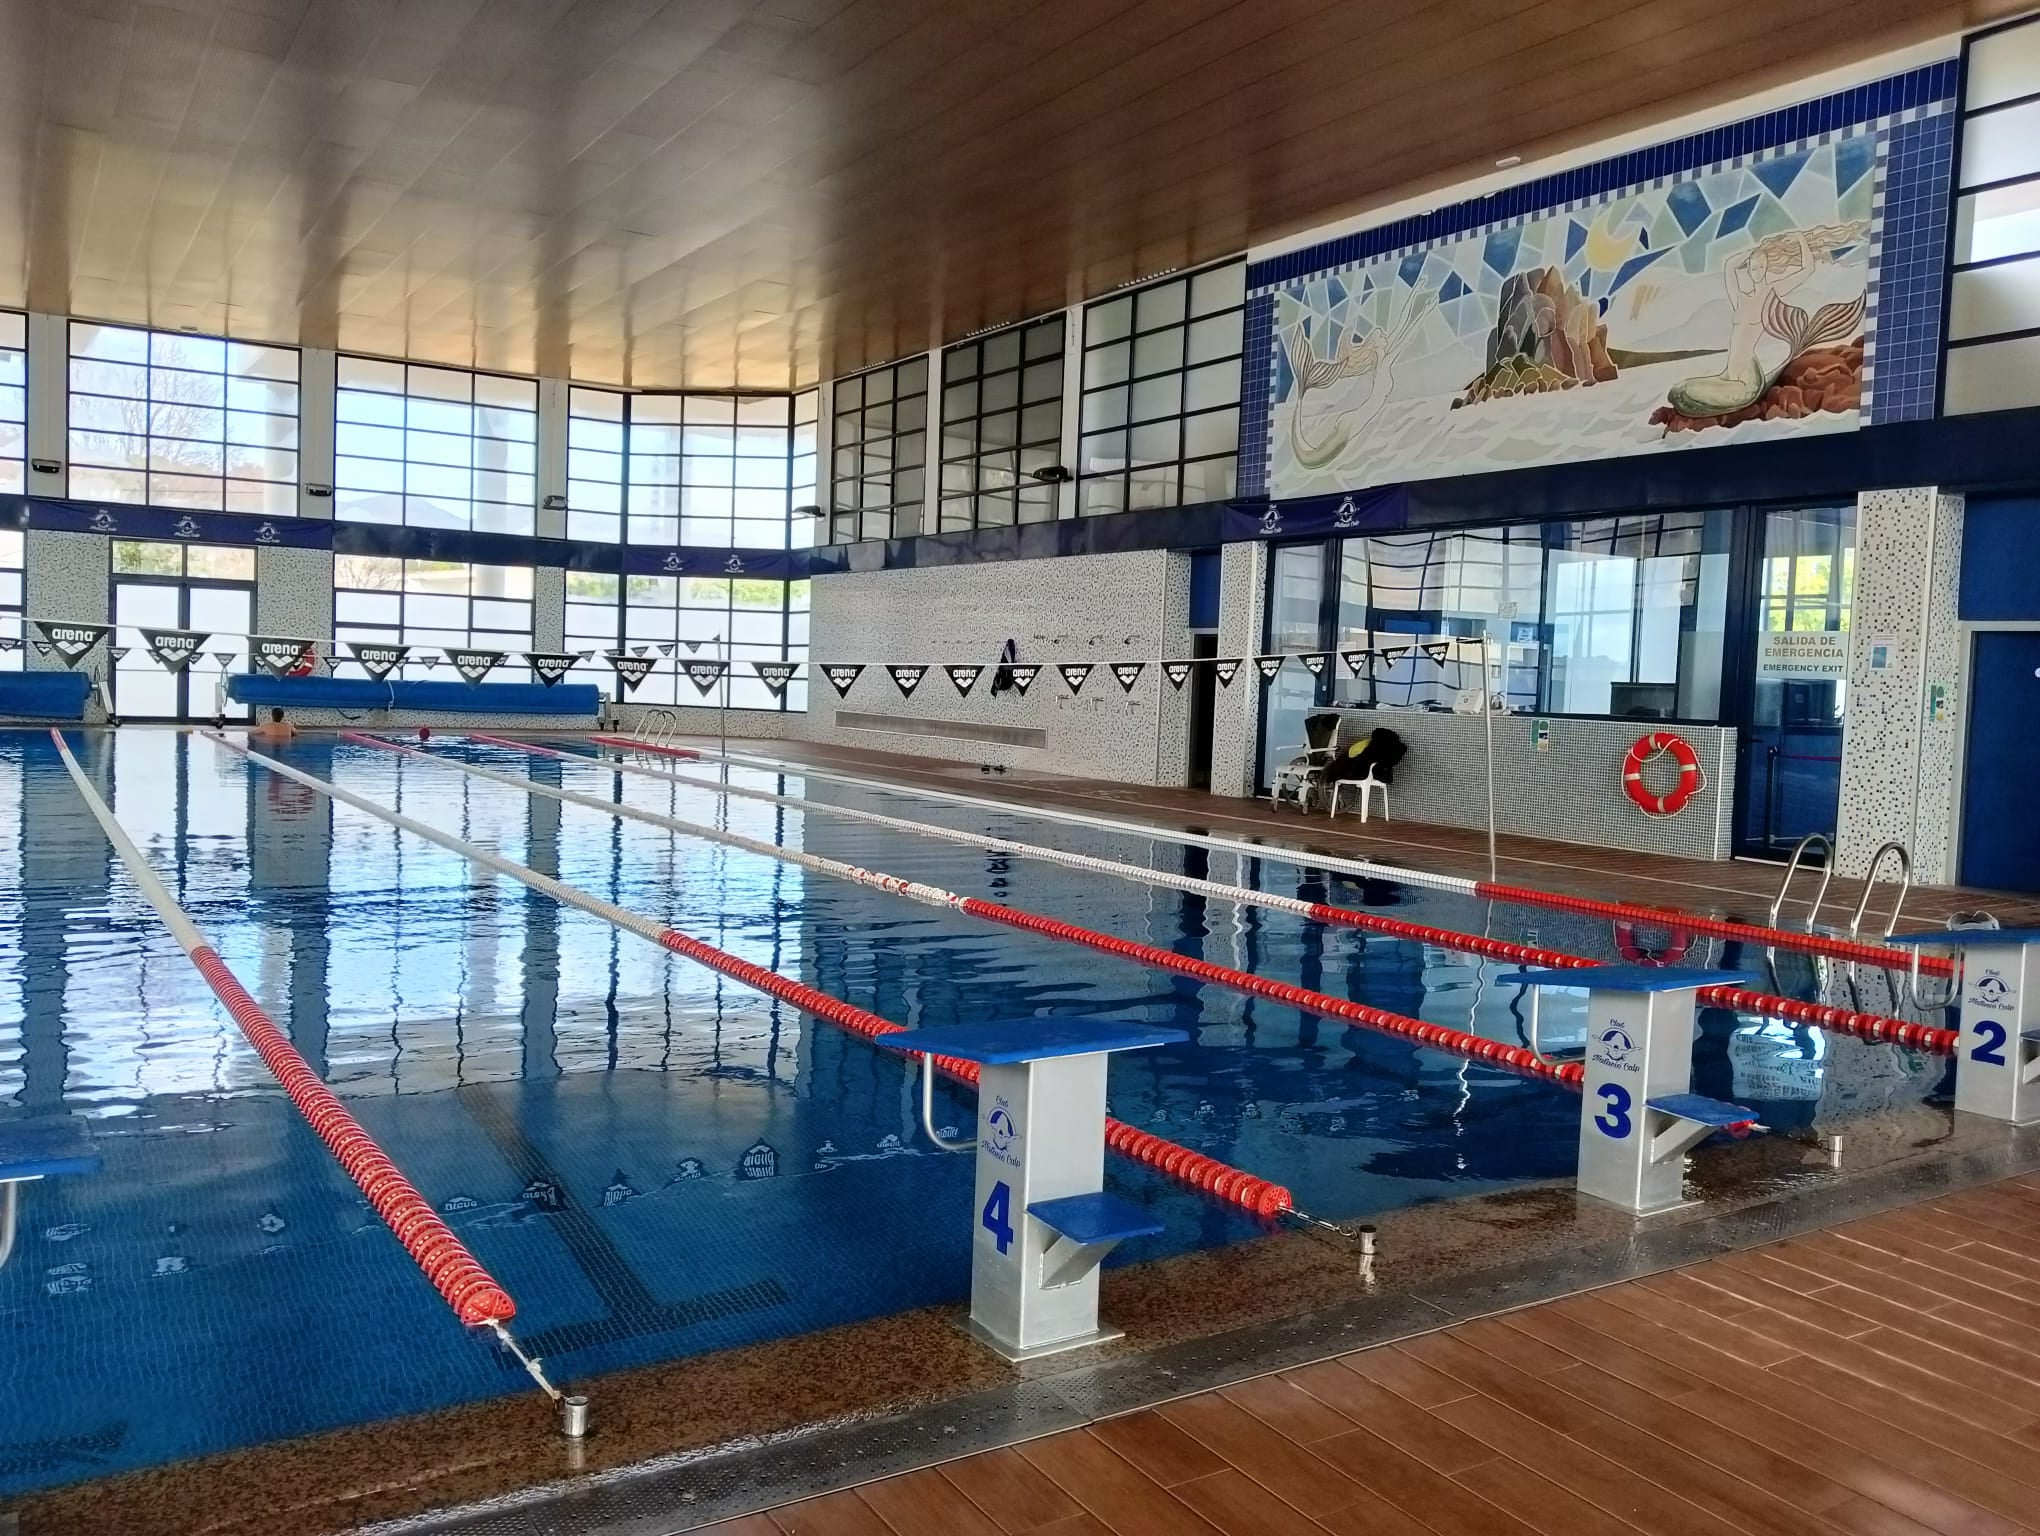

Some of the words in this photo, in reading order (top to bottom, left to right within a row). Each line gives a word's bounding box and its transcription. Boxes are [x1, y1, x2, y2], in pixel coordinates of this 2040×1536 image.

[52, 628, 95, 642] arena
[1774, 636, 1816, 645] SALIDA
[1820, 636, 1836, 645] DE
[155, 635, 195, 649] arena
[261, 642, 300, 656] arena
[1765, 648, 1843, 657] EMERGENCIA
[361, 648, 397, 662] arena
[457, 655, 491, 667] arena
[538, 658, 570, 669] arena
[617, 661, 647, 672] arena
[1261, 660, 1279, 671] arena
[691, 664, 719, 676] arena
[763, 666, 790, 677] arena
[831, 668, 856, 678] arena
[1065, 667, 1086, 677] arena
[1118, 666, 1138, 676] arena
[1169, 664, 1188, 674] arena
[1217, 663, 1236, 672] arena
[1763, 664, 1819, 672] EMERGENCY
[896, 669, 920, 679] arena
[953, 669, 976, 679] arena
[1013, 669, 1034, 678] arena
[1971, 1020, 2006, 1066] 2
[1623, 1062, 1640, 1073] Calp
[1594, 1083, 1631, 1139] 3
[982, 1180, 1014, 1256] 4
